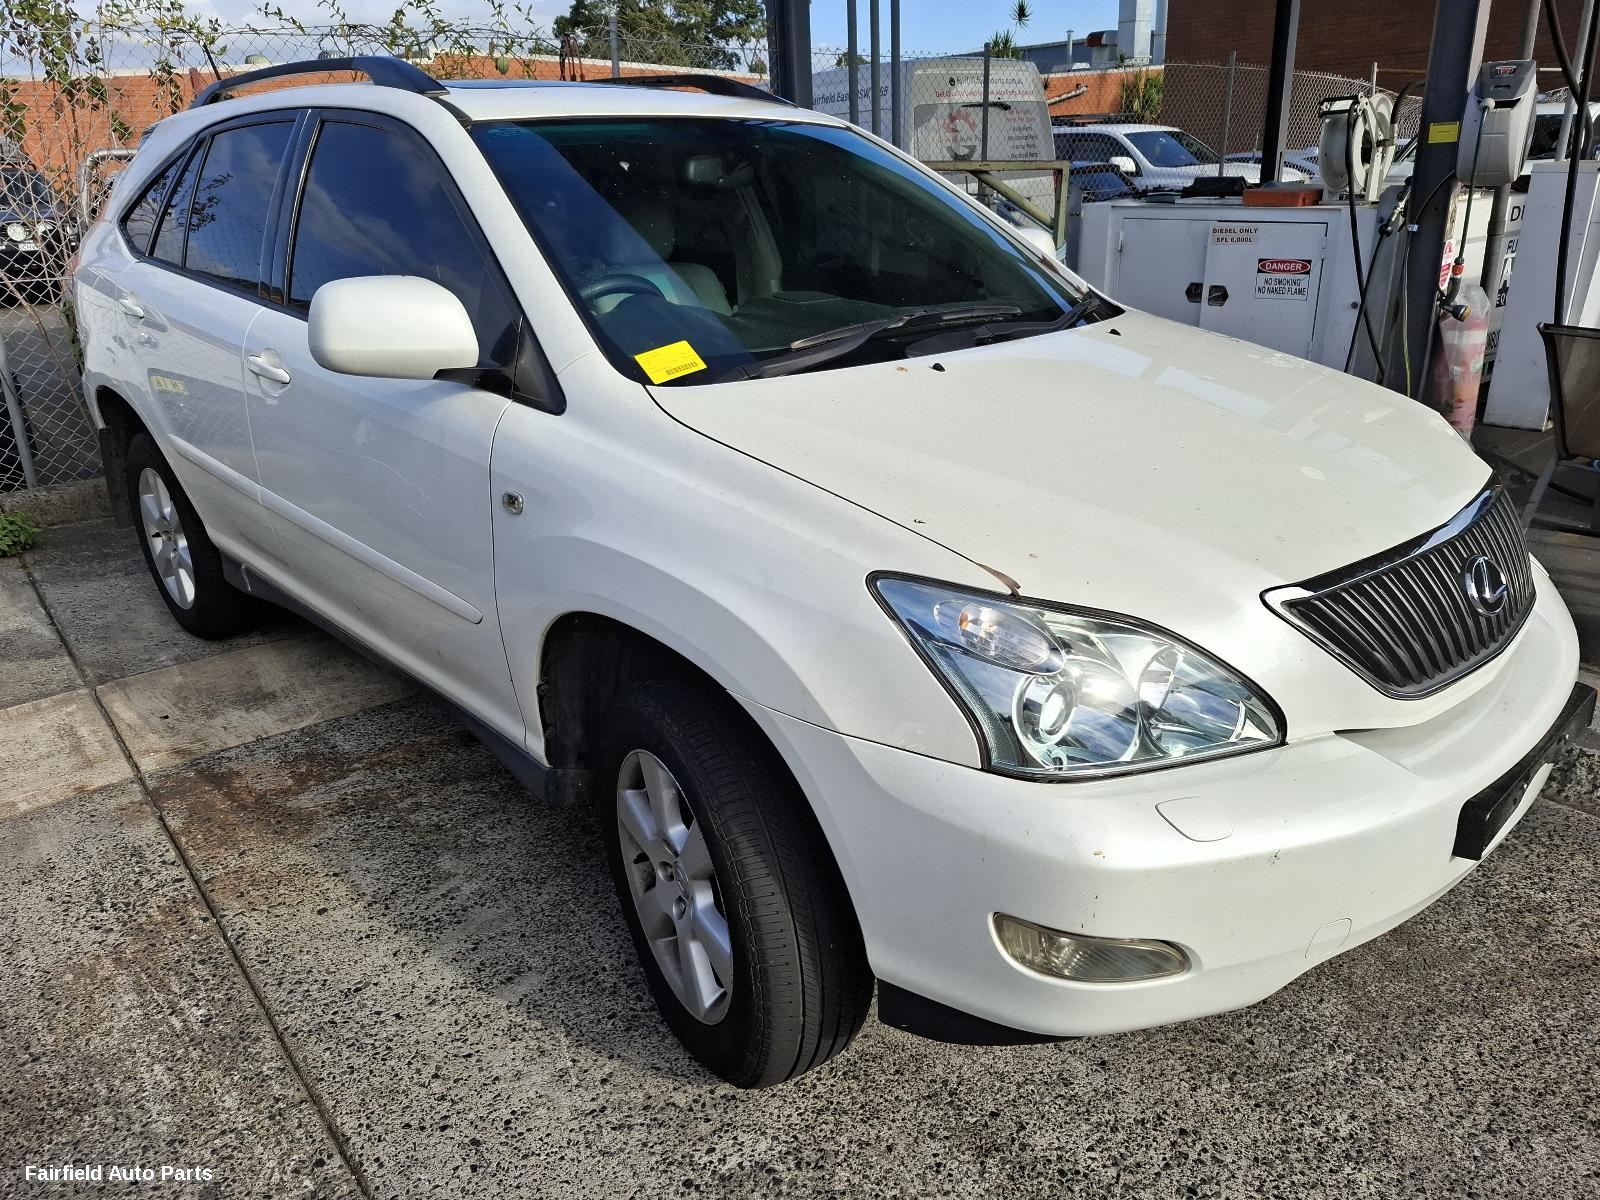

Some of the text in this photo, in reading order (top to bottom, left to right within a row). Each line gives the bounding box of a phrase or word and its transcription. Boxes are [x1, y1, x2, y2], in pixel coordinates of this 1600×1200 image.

[812, 92, 836, 106] airfield
[1265, 262, 1303, 271] DANGER
[1264, 277, 1301, 287] NO SMOKING
[1257, 286, 1306, 296] NO NAKED FLAME
